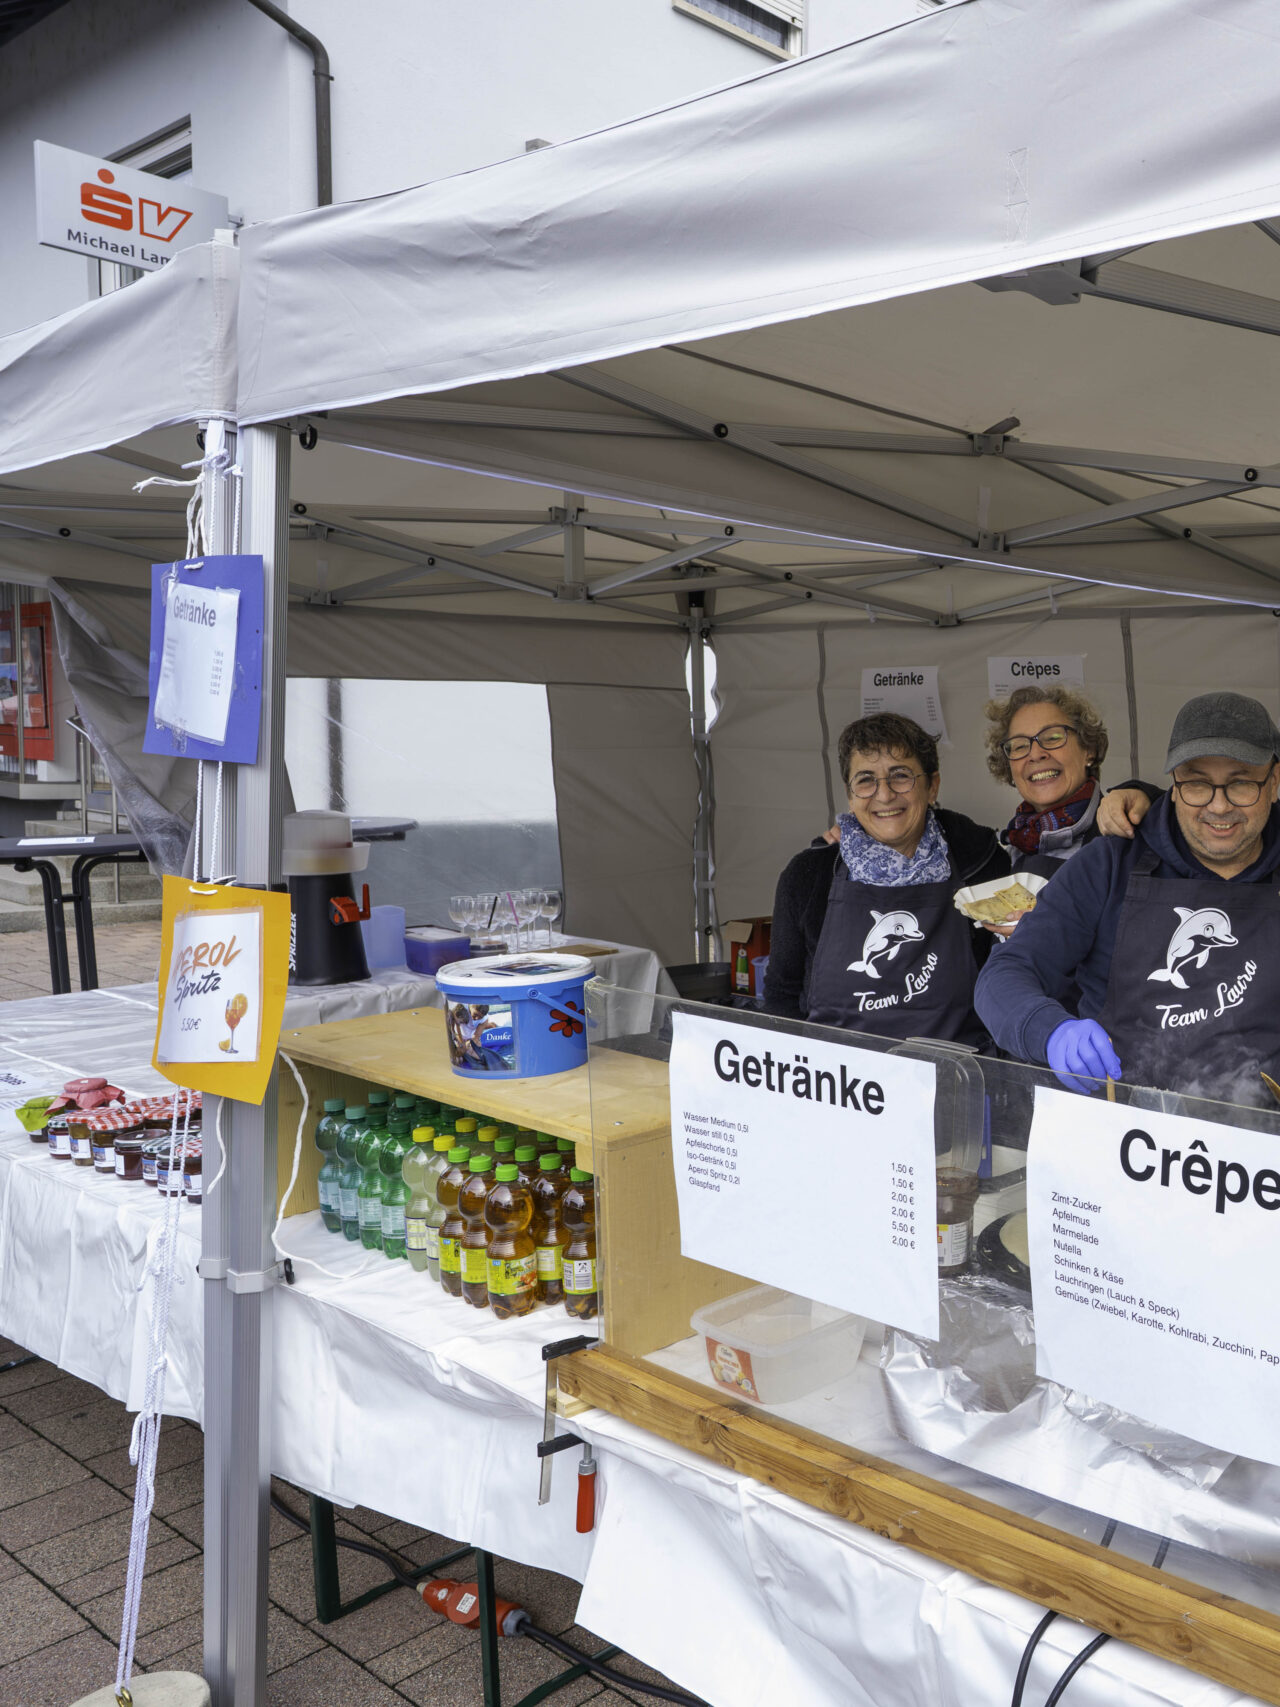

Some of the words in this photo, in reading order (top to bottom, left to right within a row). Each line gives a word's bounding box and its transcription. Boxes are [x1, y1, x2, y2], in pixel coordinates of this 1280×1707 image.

[67, 228, 135, 257] Michael
[173, 596, 217, 627] Getränke
[1011, 661, 1061, 679] Crêpes
[873, 672, 924, 687] Getränke
[288, 912, 297, 971] SPRIZZER
[174, 969, 222, 1012] Spritz
[853, 991, 899, 1012] Team
[903, 952, 939, 1003] Laura
[1155, 1004, 1208, 1030] Team
[1213, 959, 1258, 1016] Laura
[486, 1033, 512, 1041] Danke
[714, 1039, 885, 1116] Getränke
[683, 1111, 709, 1123] Wasser
[710, 1116, 736, 1129] Medium
[684, 1124, 710, 1136] Wasser
[685, 1138, 725, 1153] Apfelschorle
[686, 1151, 724, 1166] Iso-Getränk
[688, 1163, 709, 1176] Aperol
[709, 1168, 727, 1181] Spritz
[891, 1162, 907, 1174] 1,50
[908, 1166, 914, 1176] €
[689, 1176, 721, 1192] Glaspfand
[891, 1177, 907, 1189] 1,50
[909, 1181, 914, 1190] €
[891, 1191, 908, 1204] 2,00
[909, 1196, 914, 1205] €
[1051, 1191, 1102, 1213] Zimt-Zucker
[891, 1206, 908, 1218] 2,00
[909, 1211, 915, 1220] €
[1052, 1208, 1090, 1227] Apfelmus
[891, 1221, 908, 1233] 5,50
[910, 1226, 915, 1235] €
[1052, 1223, 1099, 1245] Marmelade
[892, 1235, 908, 1248] 2,00
[910, 1240, 916, 1249] €
[1053, 1239, 1082, 1256] Nutella
[1054, 1254, 1091, 1275] Schinken
[1093, 1267, 1099, 1277] &
[1102, 1270, 1124, 1285] Käse
[1054, 1270, 1104, 1295] Lauchringen
[1106, 1288, 1136, 1305] (Lauch
[1138, 1298, 1145, 1308] &
[1148, 1300, 1180, 1320] Speck)
[1055, 1286, 1089, 1305] Gemüse
[1091, 1298, 1129, 1320] (Zwiebel,
[1131, 1312, 1166, 1332] Karotte,
[1168, 1323, 1209, 1346] Kohlrabi,
[1212, 1336, 1256, 1359] Zucchini,
